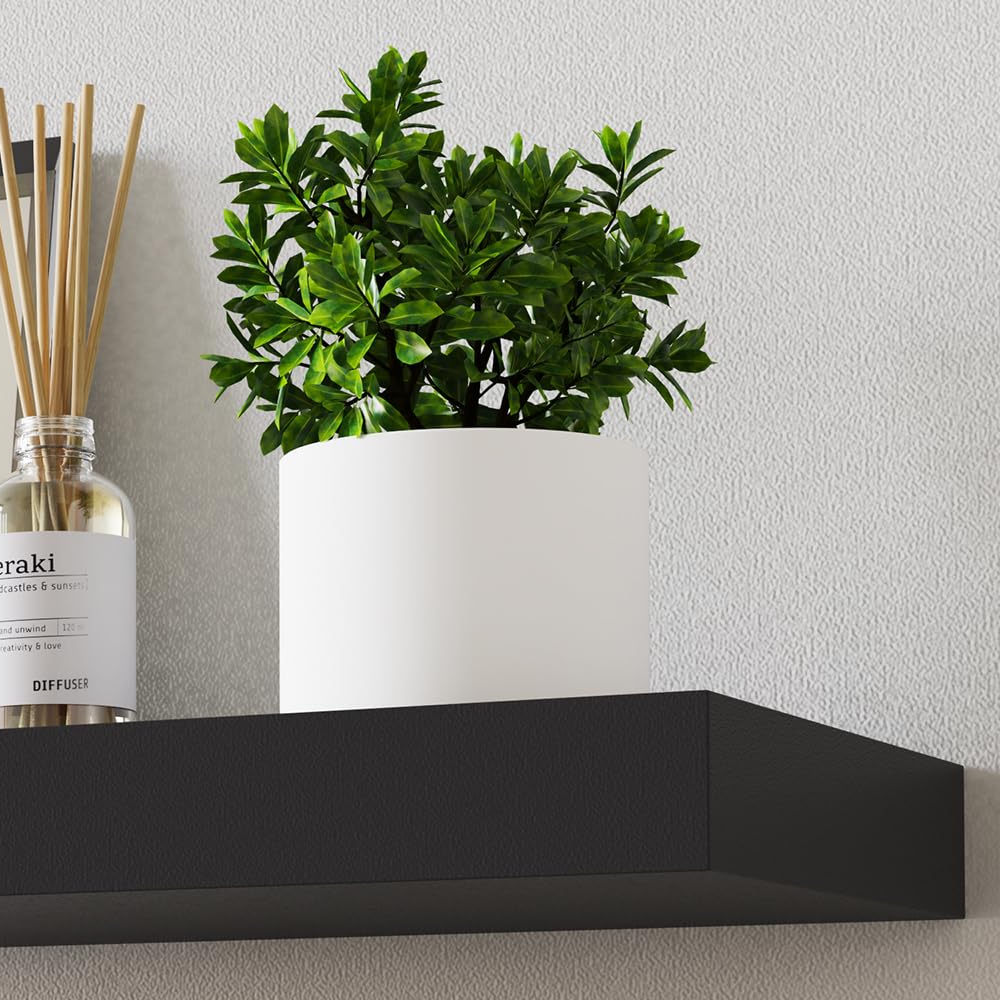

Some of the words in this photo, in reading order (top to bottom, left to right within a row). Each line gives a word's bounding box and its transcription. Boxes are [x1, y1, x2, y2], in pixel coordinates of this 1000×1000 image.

[41, 582, 47, 591] &
[14, 624, 46, 634] unwind
[36, 642, 41, 650] &
[44, 642, 62, 650] love
[33, 678, 88, 692] DIFFUSER
